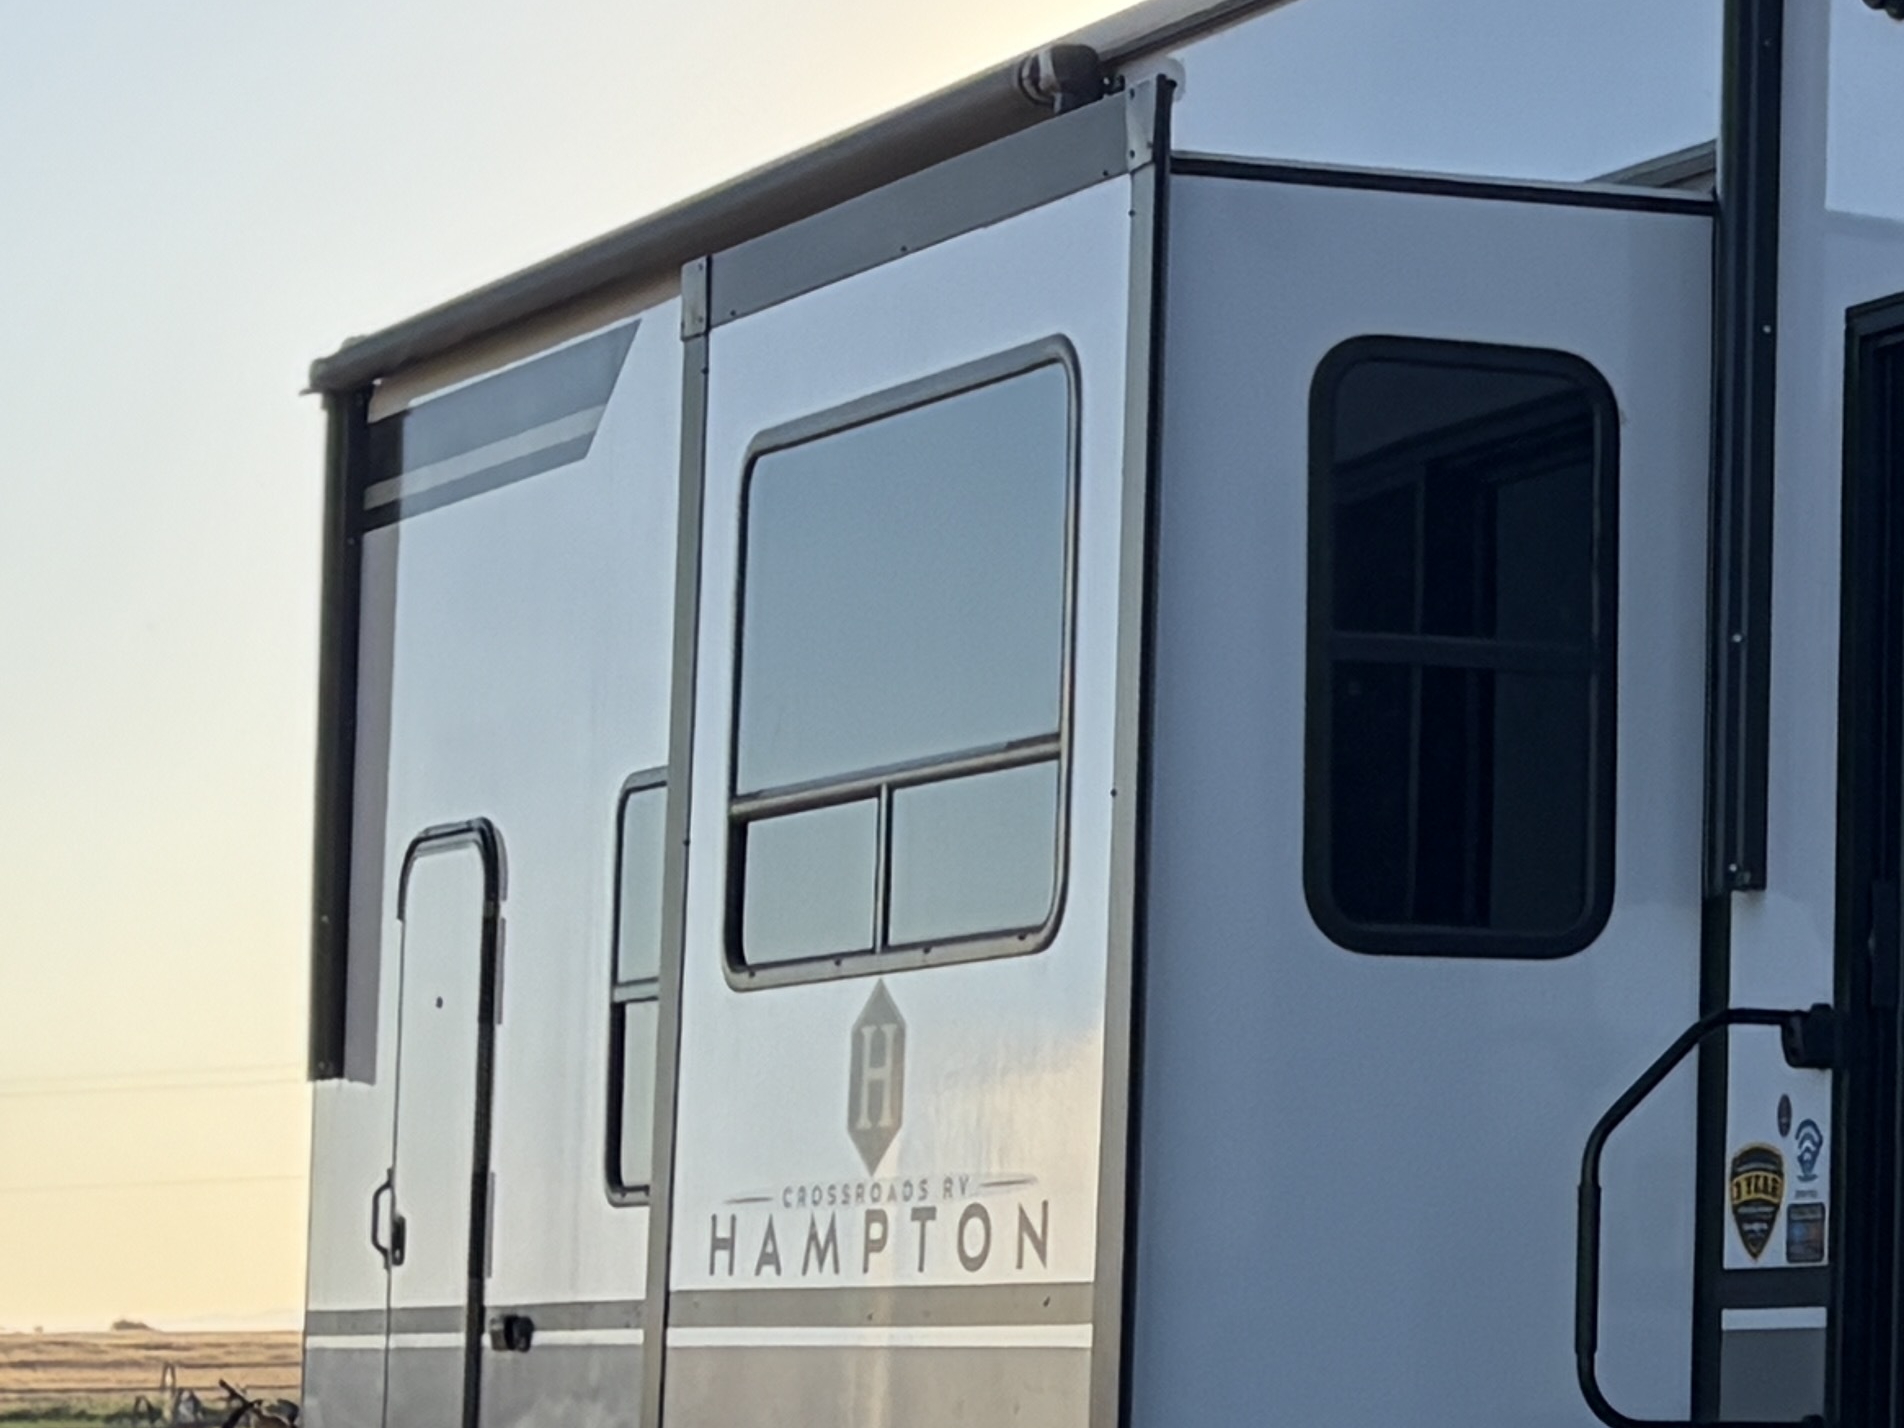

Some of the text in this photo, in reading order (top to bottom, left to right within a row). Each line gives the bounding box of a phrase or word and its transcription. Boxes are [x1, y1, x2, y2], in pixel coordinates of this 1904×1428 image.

[857, 1024, 897, 1129] H
[782, 1175, 971, 1208] CROSSROADS RV
[708, 1199, 1050, 1277] HAMPTON
